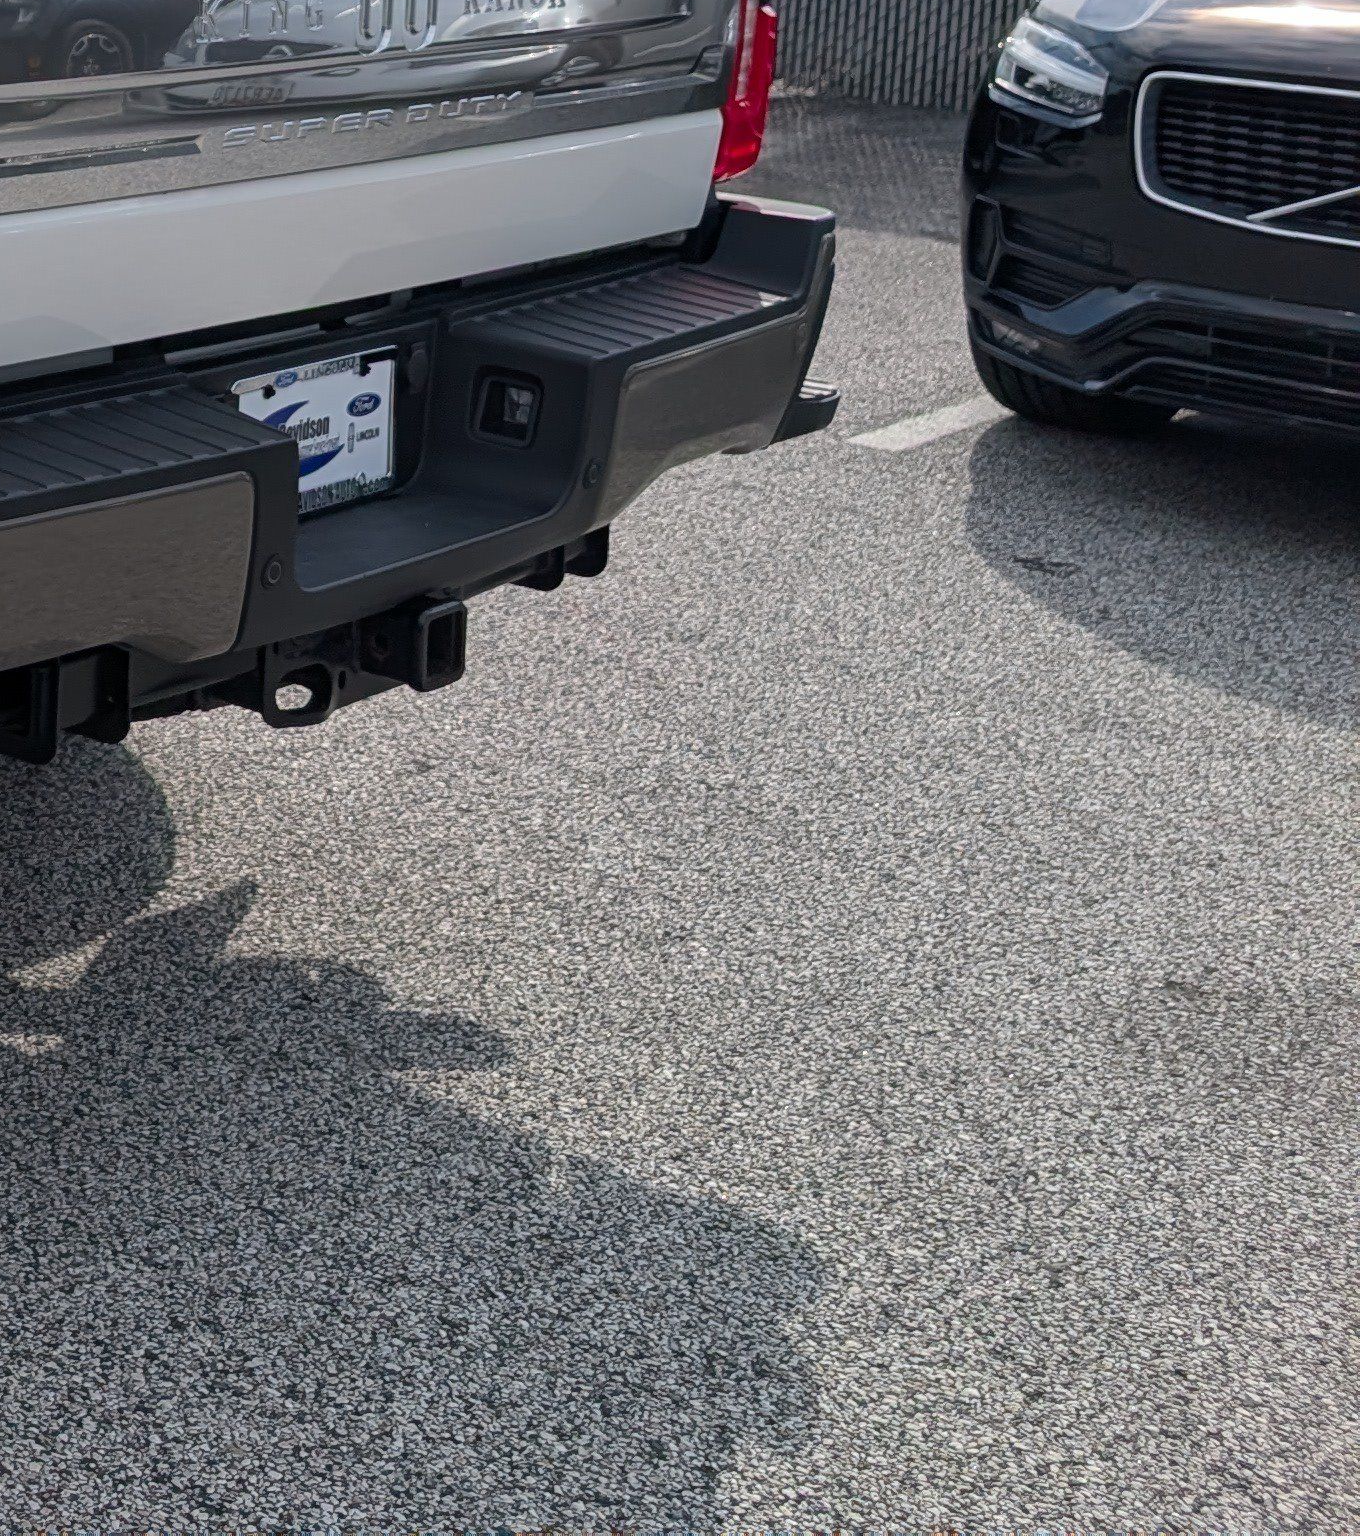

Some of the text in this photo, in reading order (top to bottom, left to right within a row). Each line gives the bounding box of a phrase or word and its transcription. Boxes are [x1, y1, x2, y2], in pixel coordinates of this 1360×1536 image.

[222, 90, 524, 147] SUPER DUTY
[356, 427, 380, 442] LINCOLN
